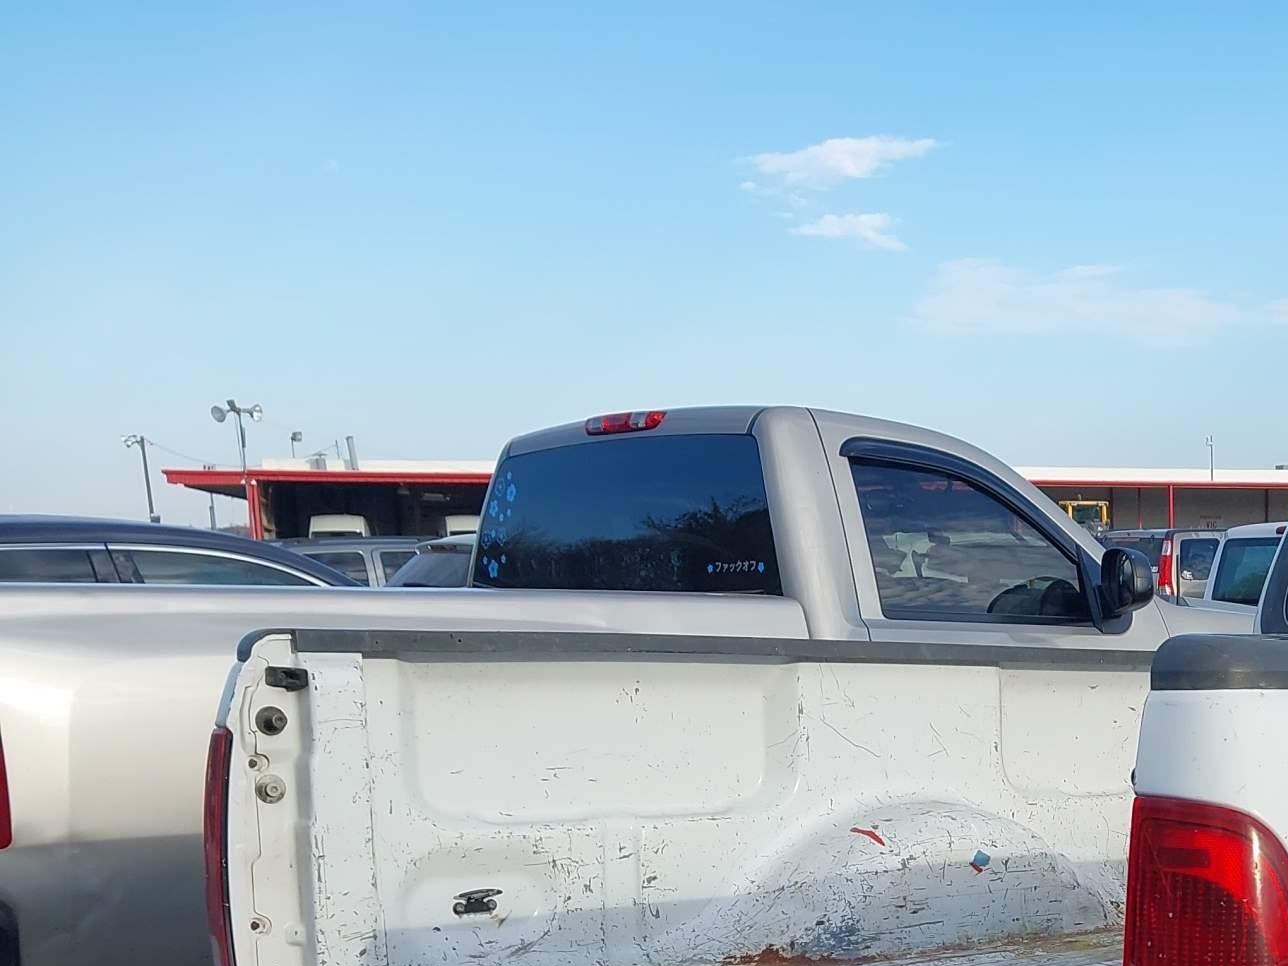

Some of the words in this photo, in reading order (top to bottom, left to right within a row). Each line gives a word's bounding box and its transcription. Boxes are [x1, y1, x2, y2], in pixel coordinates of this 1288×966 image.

[715, 560, 756, 572] ファックオフ
